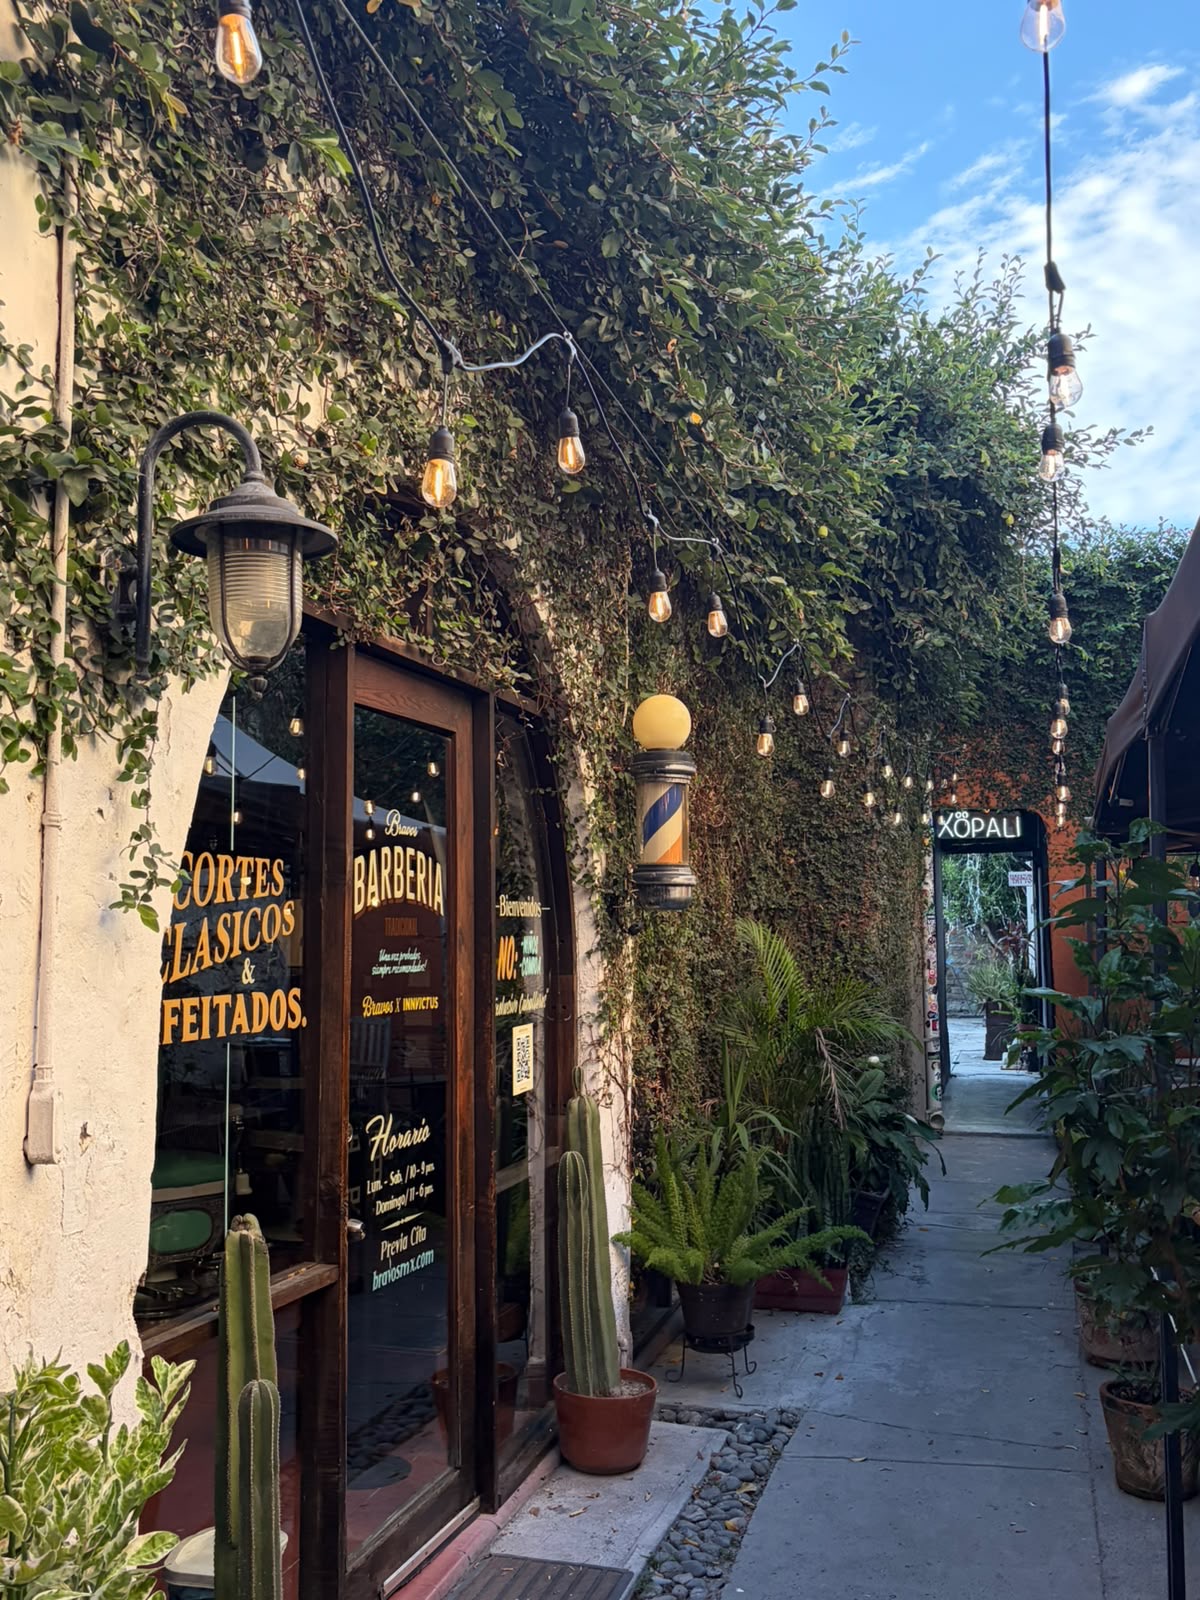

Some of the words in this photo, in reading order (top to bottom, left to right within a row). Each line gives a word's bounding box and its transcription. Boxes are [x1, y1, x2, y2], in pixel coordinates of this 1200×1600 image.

[385, 809, 418, 837] Bravos
[173, 851, 285, 910] CORTES
[354, 845, 444, 916] BARBERIA
[241, 957, 255, 985] &
[497, 935, 518, 981] NO:
[159, 987, 307, 1046] FEITADOS.
[363, 996, 394, 1018] Bravos
[403, 997, 439, 1011] INNVICTUS
[365, 1113, 431, 1161] Horario
[381, 1232, 408, 1261] Previa
[410, 1225, 427, 1246] Cita
[372, 1249, 434, 1291] bravosmx.com
